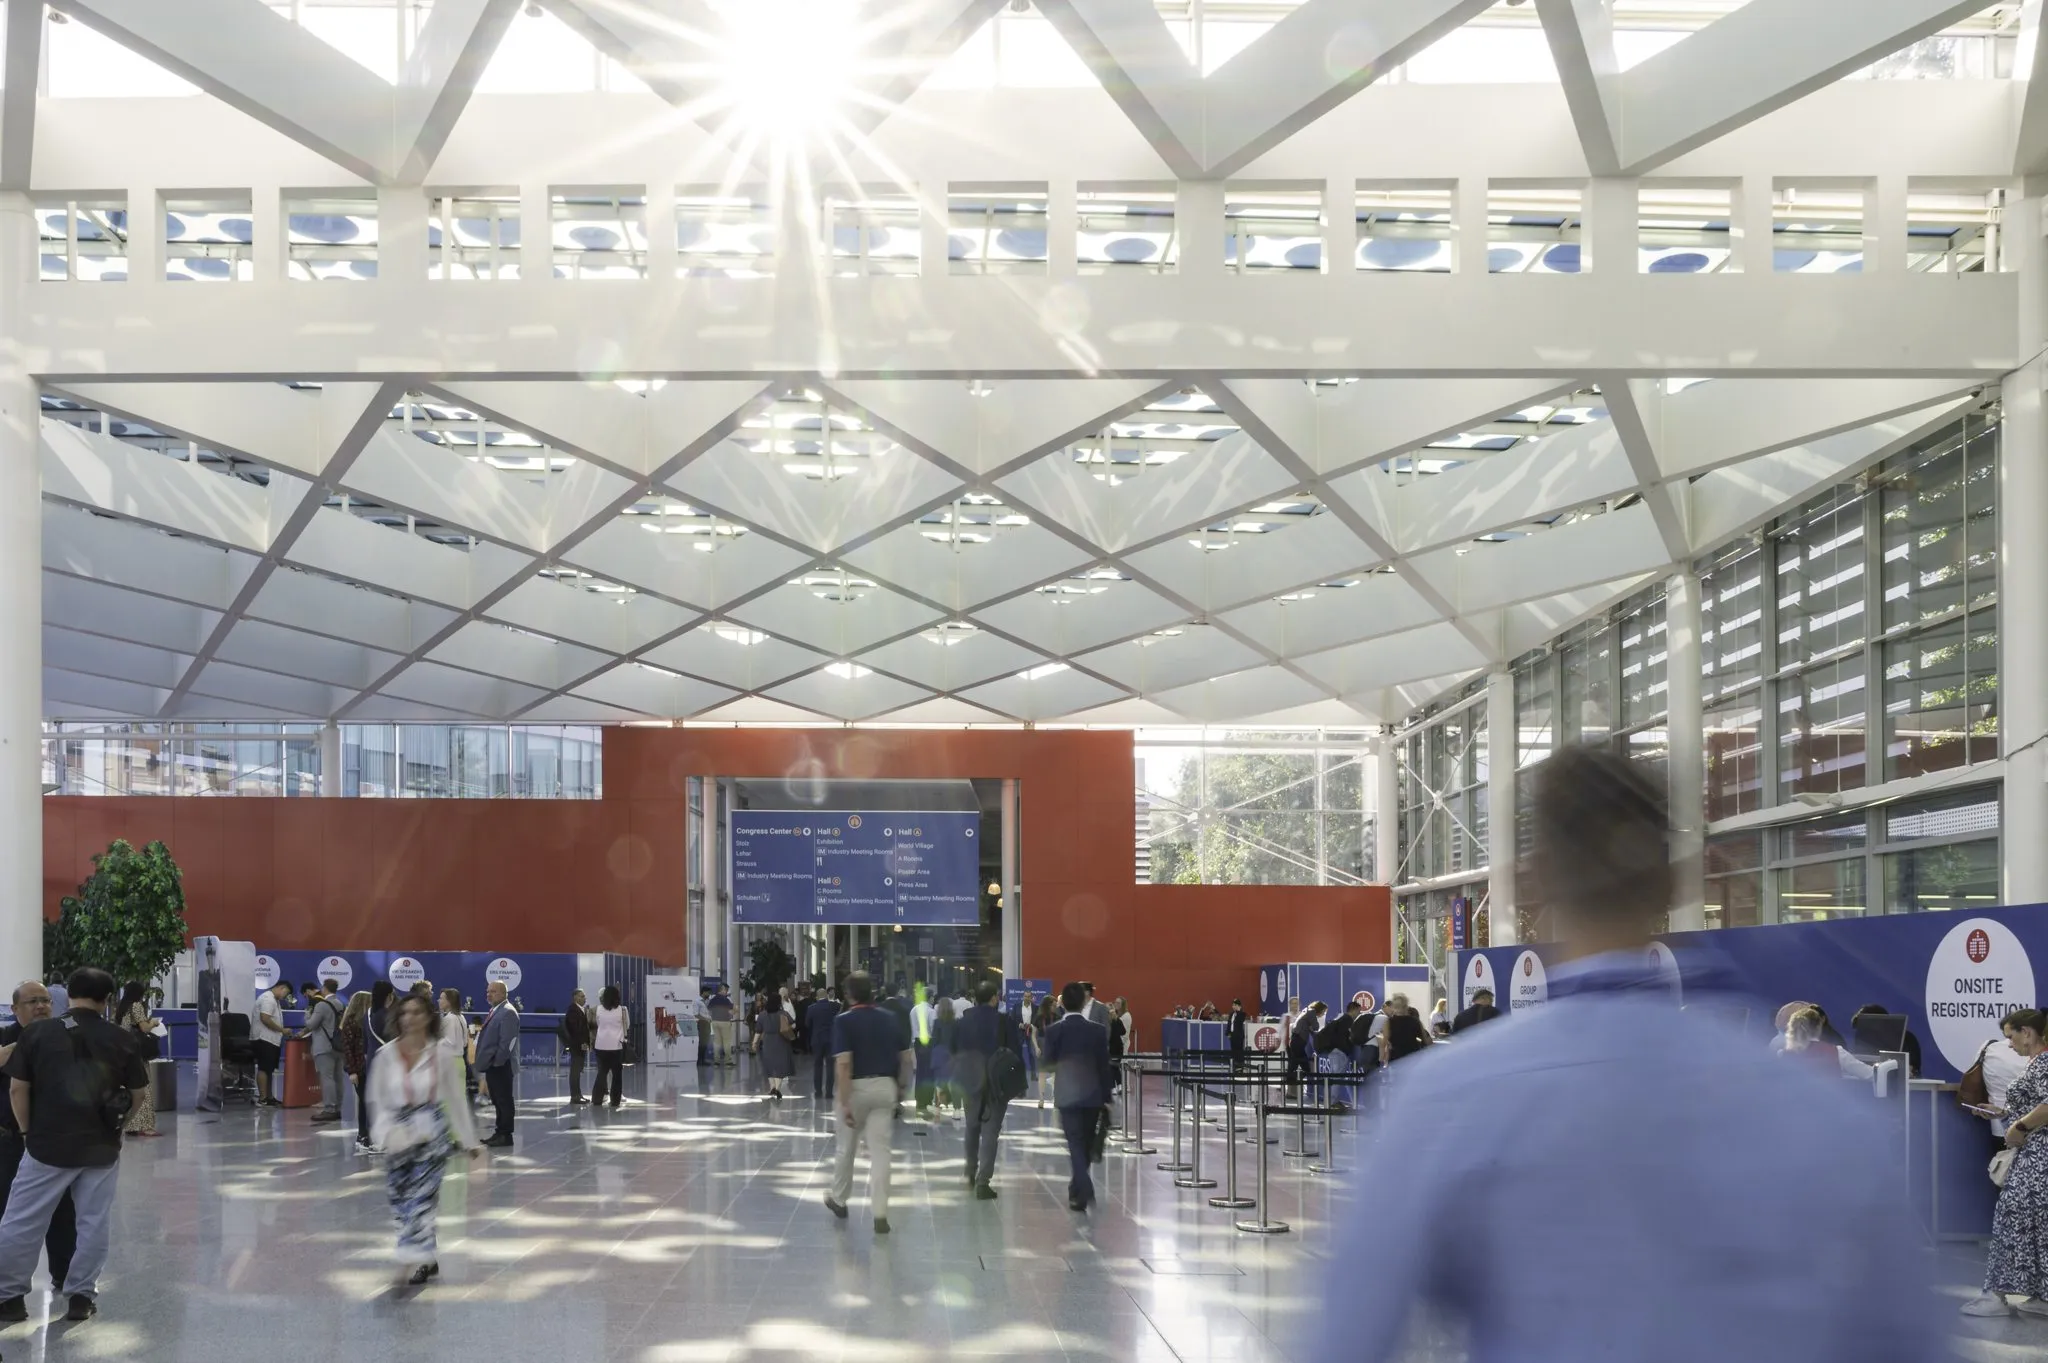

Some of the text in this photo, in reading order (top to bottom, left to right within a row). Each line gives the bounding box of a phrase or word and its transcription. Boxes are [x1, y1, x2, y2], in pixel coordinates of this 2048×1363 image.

[1520, 986, 1536, 995] GROUP
[1954, 978, 2003, 994] ONSITE
[1319, 1057, 1331, 1073] ERS
